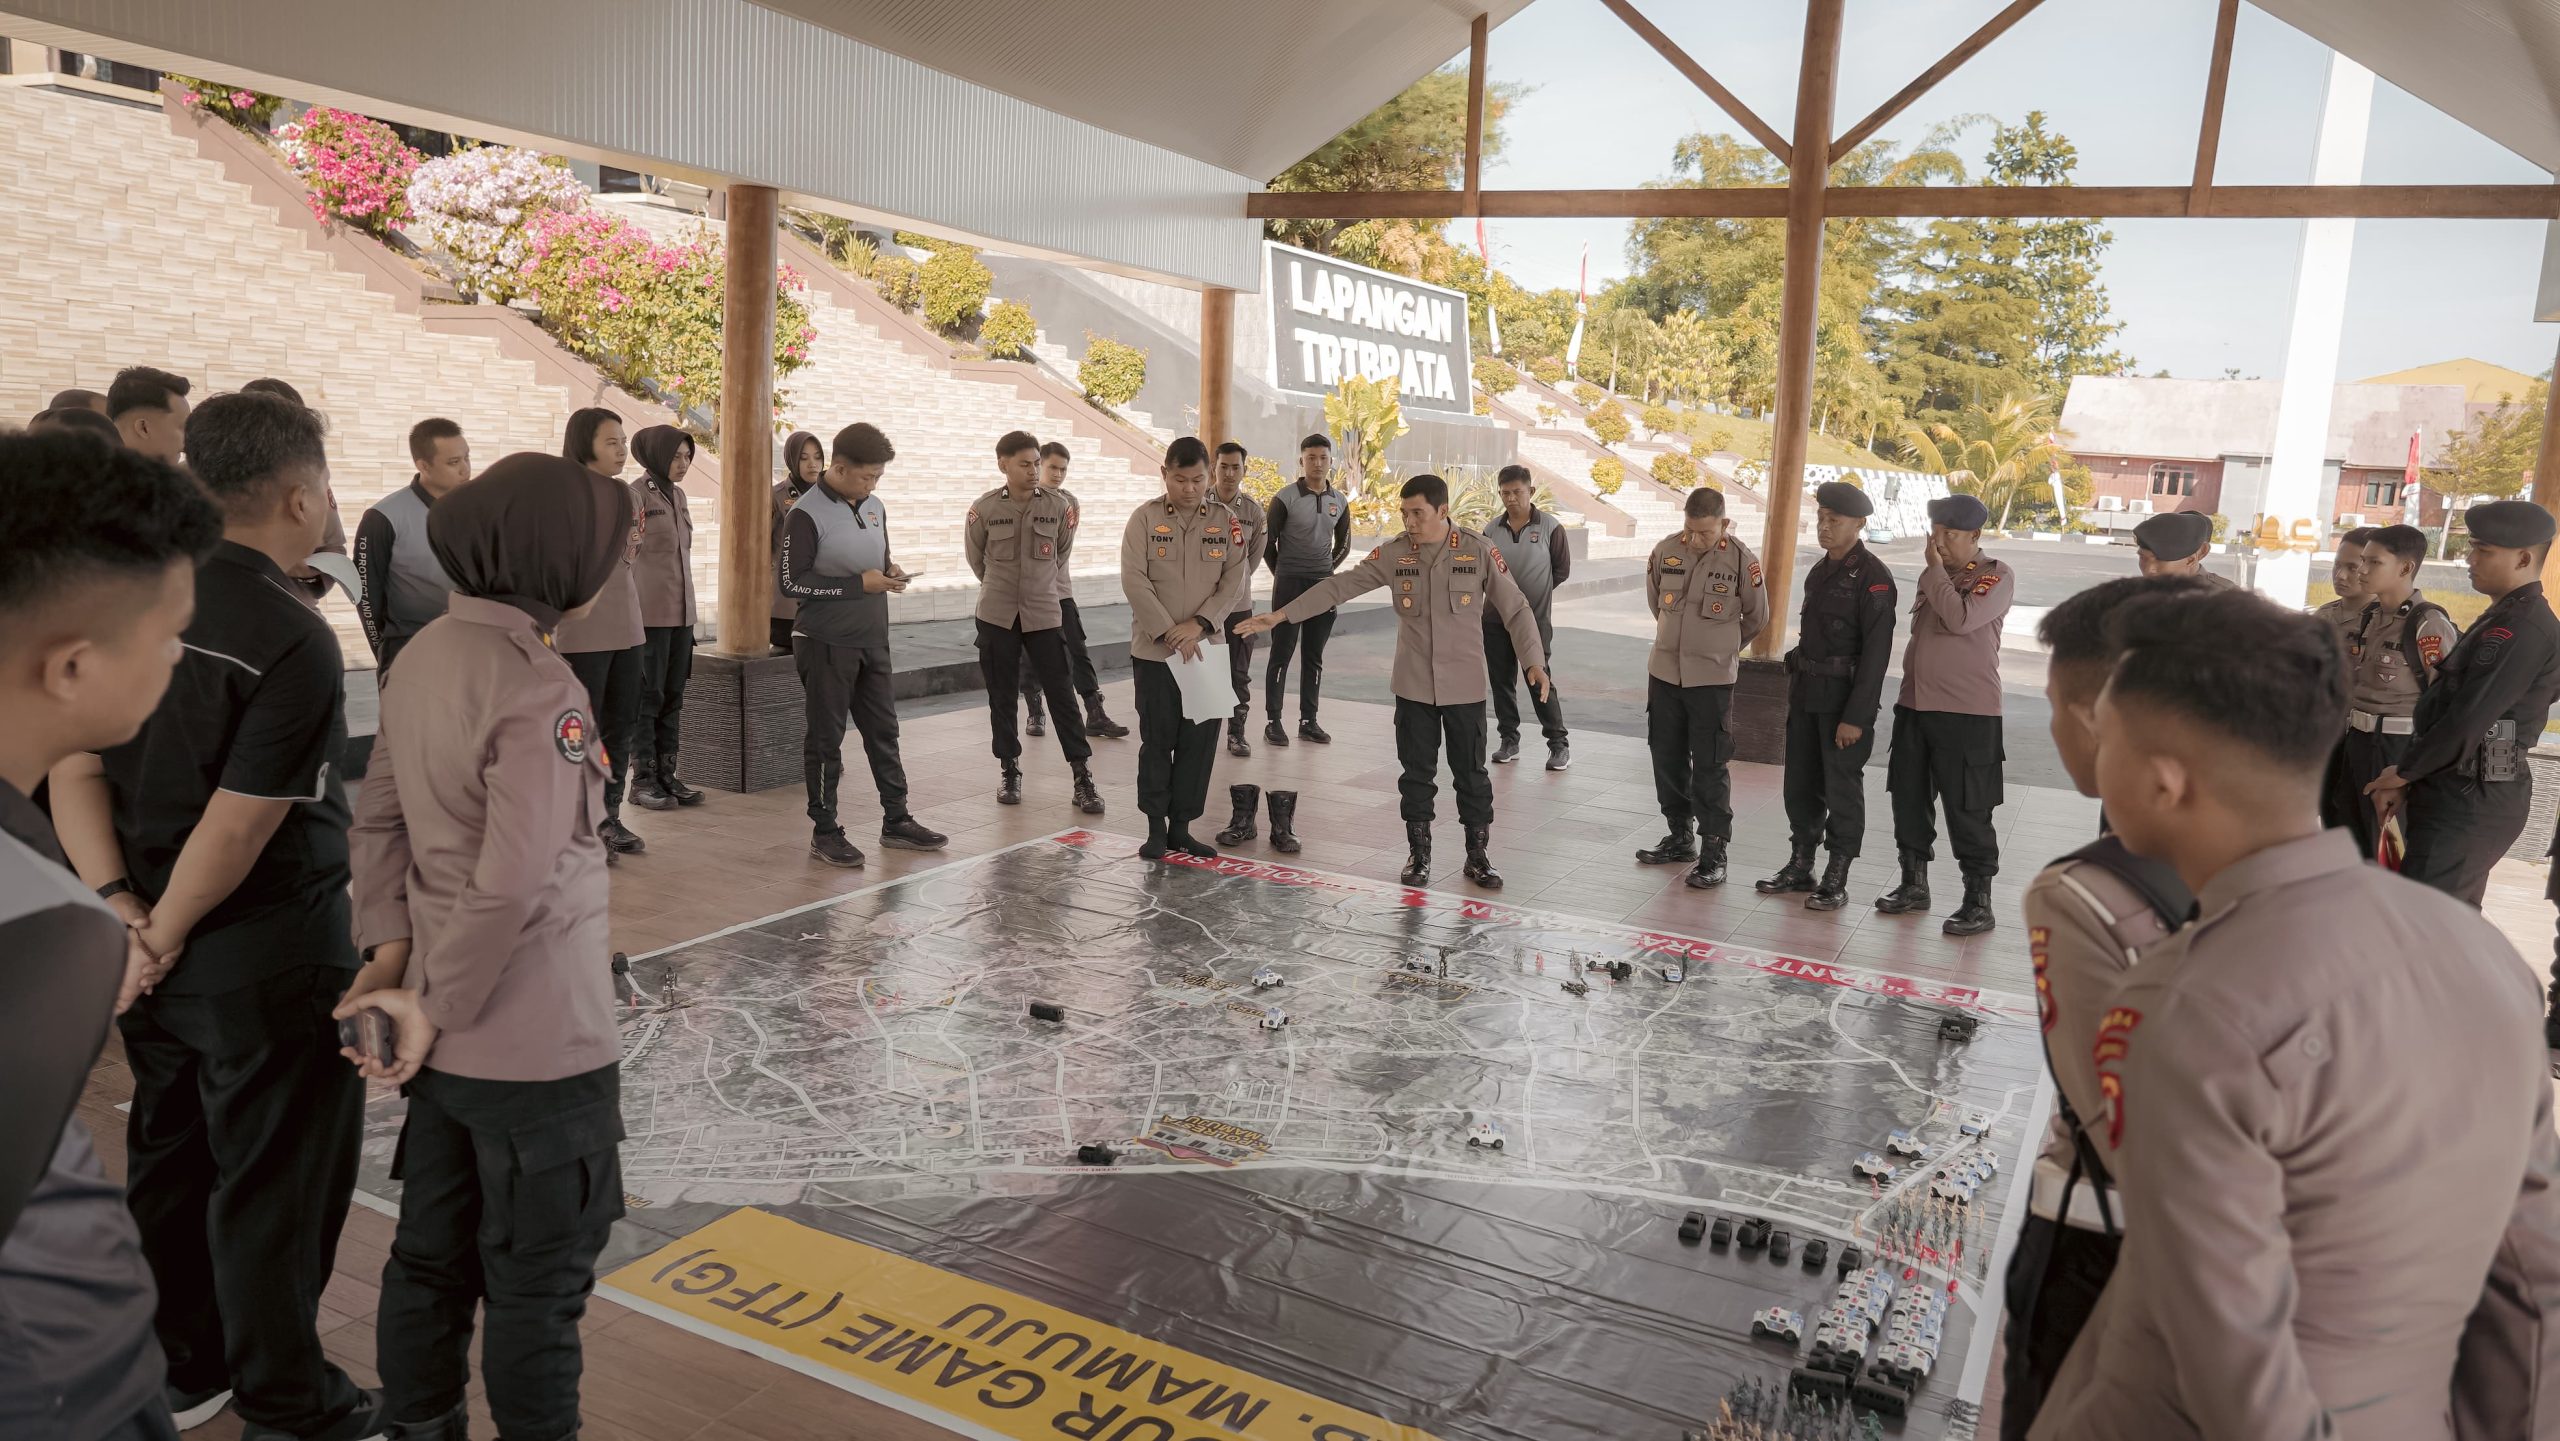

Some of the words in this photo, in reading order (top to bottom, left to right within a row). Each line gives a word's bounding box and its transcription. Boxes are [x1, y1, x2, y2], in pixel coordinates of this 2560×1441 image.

[1290, 261, 1452, 343] LAPANGAN
[1294, 328, 1456, 401] TRIBRATA
[1034, 516, 1058, 525] POLRI
[359, 536, 367, 550] TO
[783, 534, 791, 549] TO
[1151, 535, 1174, 543] TONY
[1202, 537, 1227, 545] POLRI
[358, 552, 369, 599] PROTECT
[782, 549, 792, 590] PROTECT
[1452, 566, 1477, 575] POLRI
[1708, 572, 1737, 582] POLRI
[791, 584, 812, 595] AND
[361, 599, 372, 618] AND
[1217, 860, 1320, 884] POLDA
[651, 1248, 845, 1331] (TFG)
[820, 1313, 1047, 1409] GAME
[936, 1303, 1271, 1434] MAMUJU
